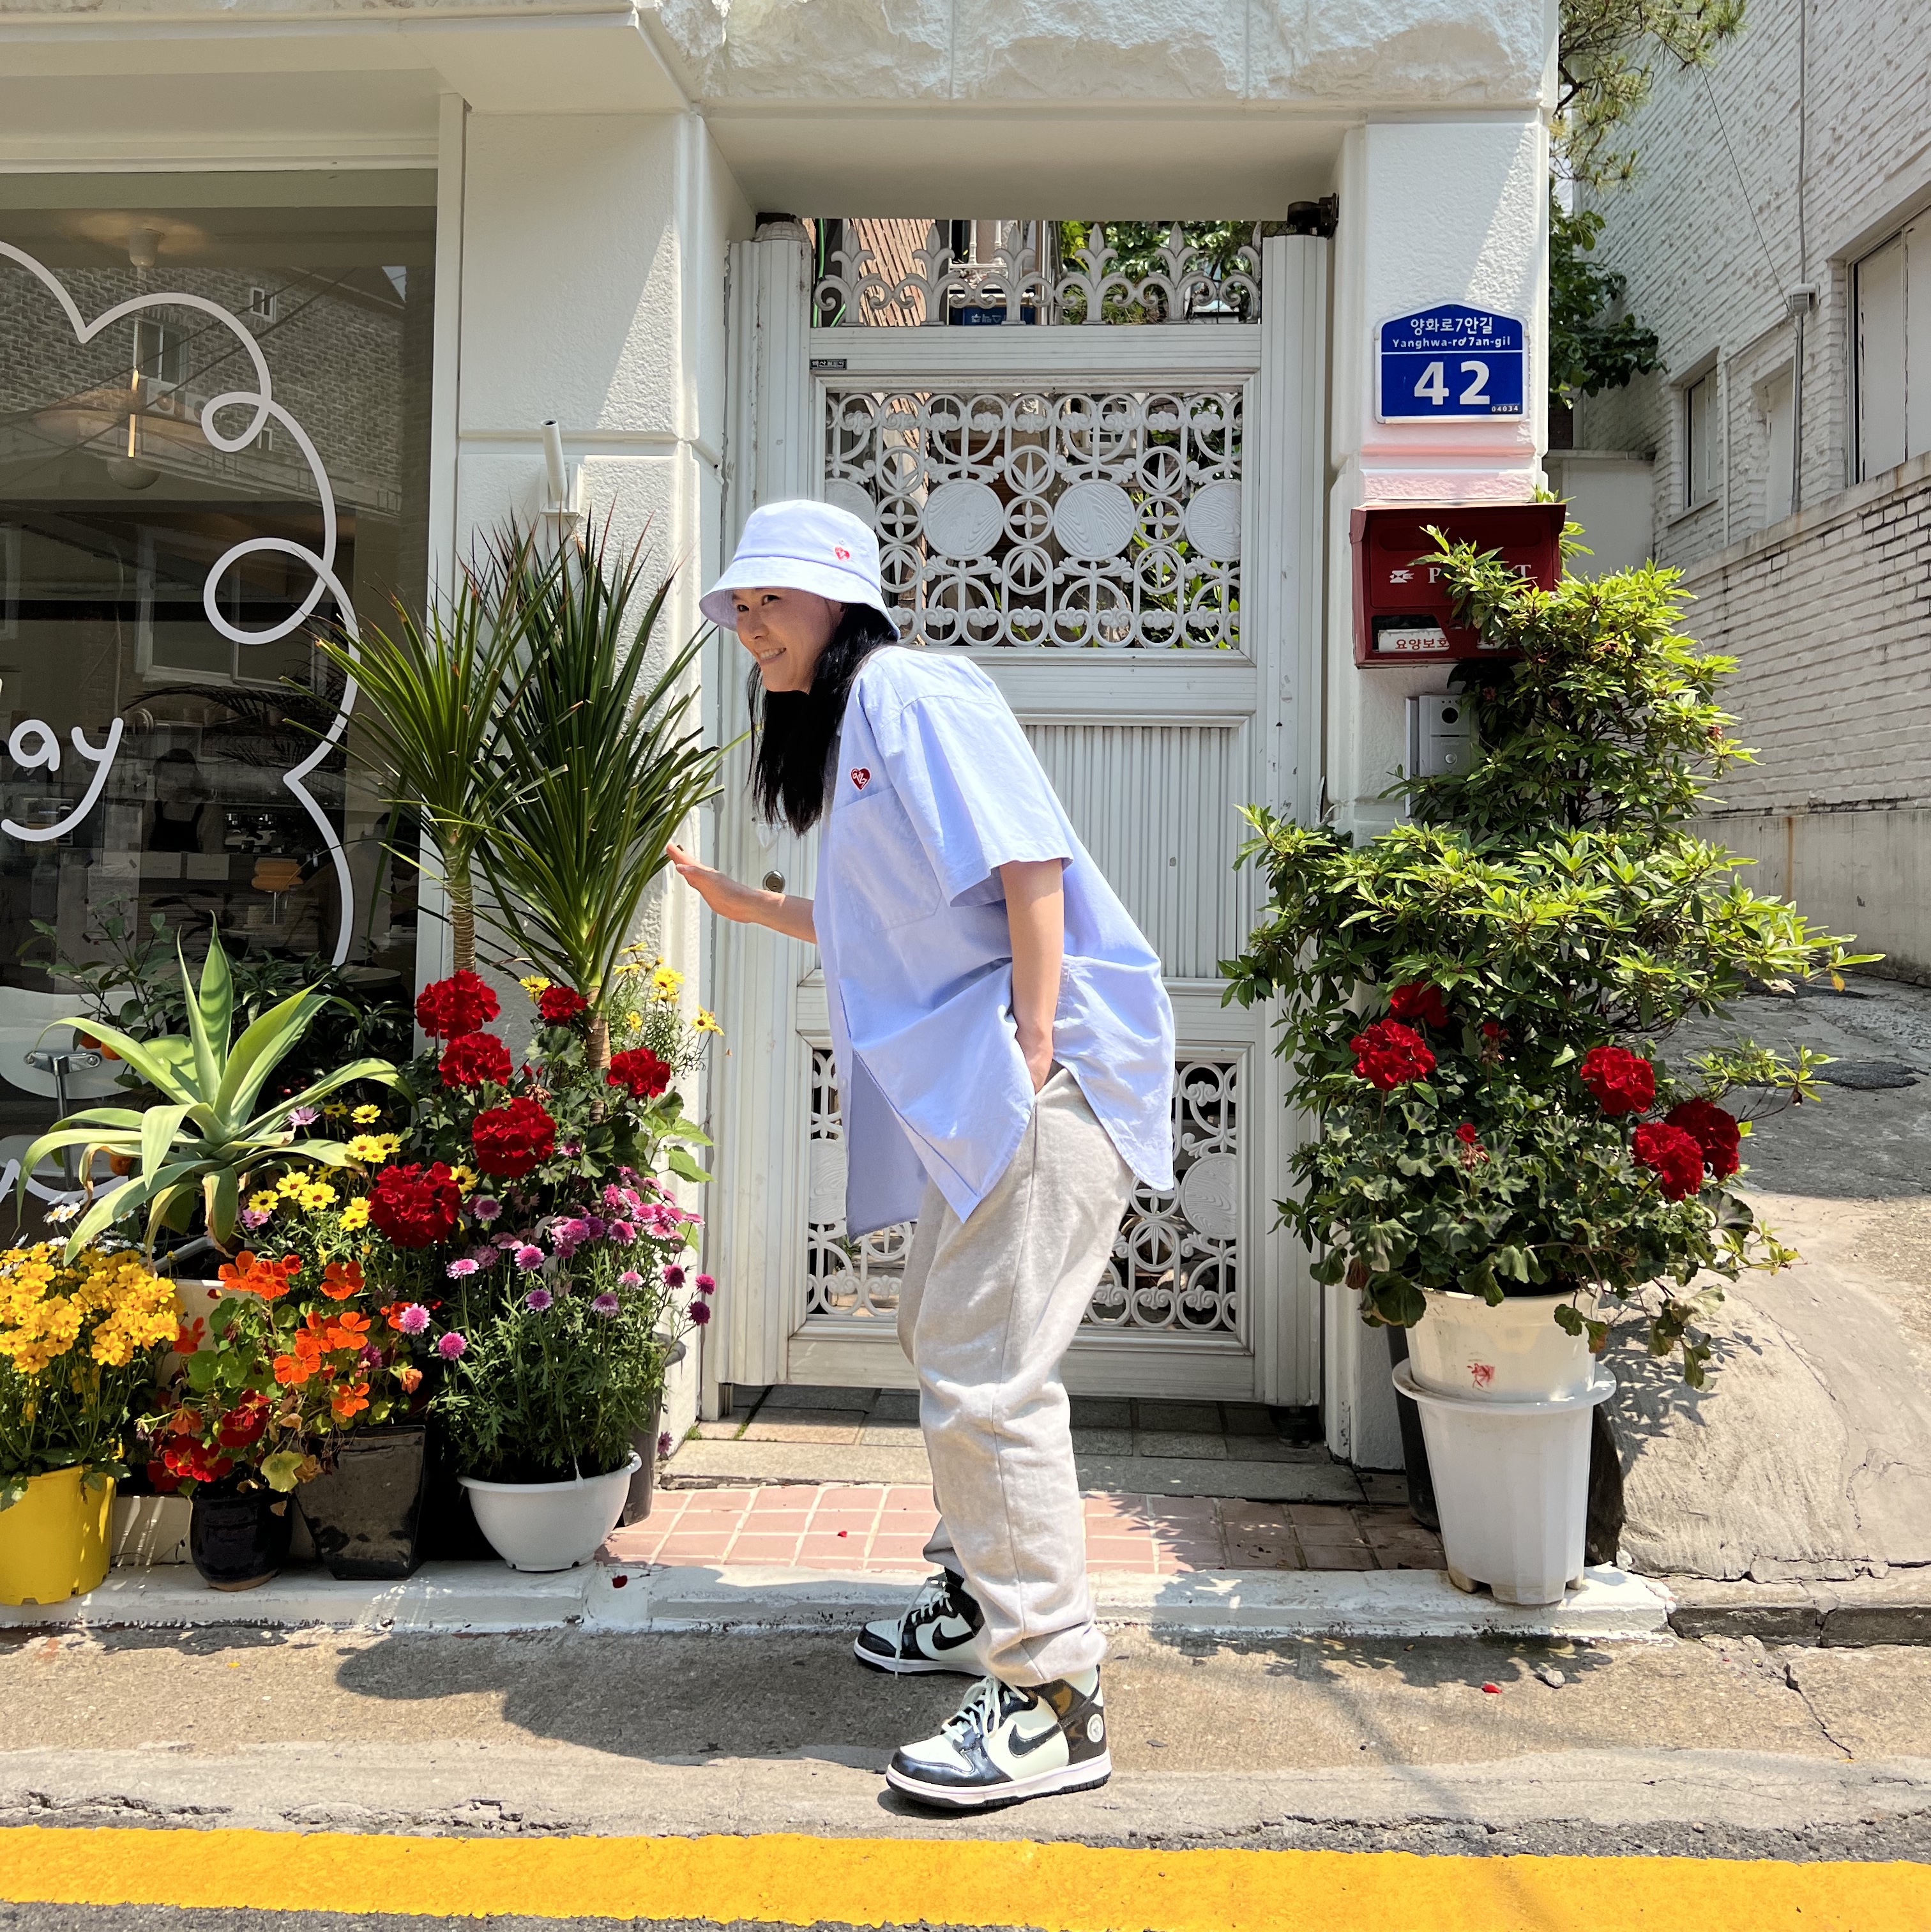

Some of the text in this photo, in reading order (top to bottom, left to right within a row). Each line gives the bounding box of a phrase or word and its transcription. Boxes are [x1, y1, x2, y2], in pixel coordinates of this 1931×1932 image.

[1411, 317, 1492, 336] 양화로7안길
[1468, 337, 1510, 348] 7an-gil
[1414, 360, 1490, 405] 42
[1427, 565, 1531, 584] PT
[1395, 638, 1450, 651] 요양보호
[0, 678, 124, 842] ay
